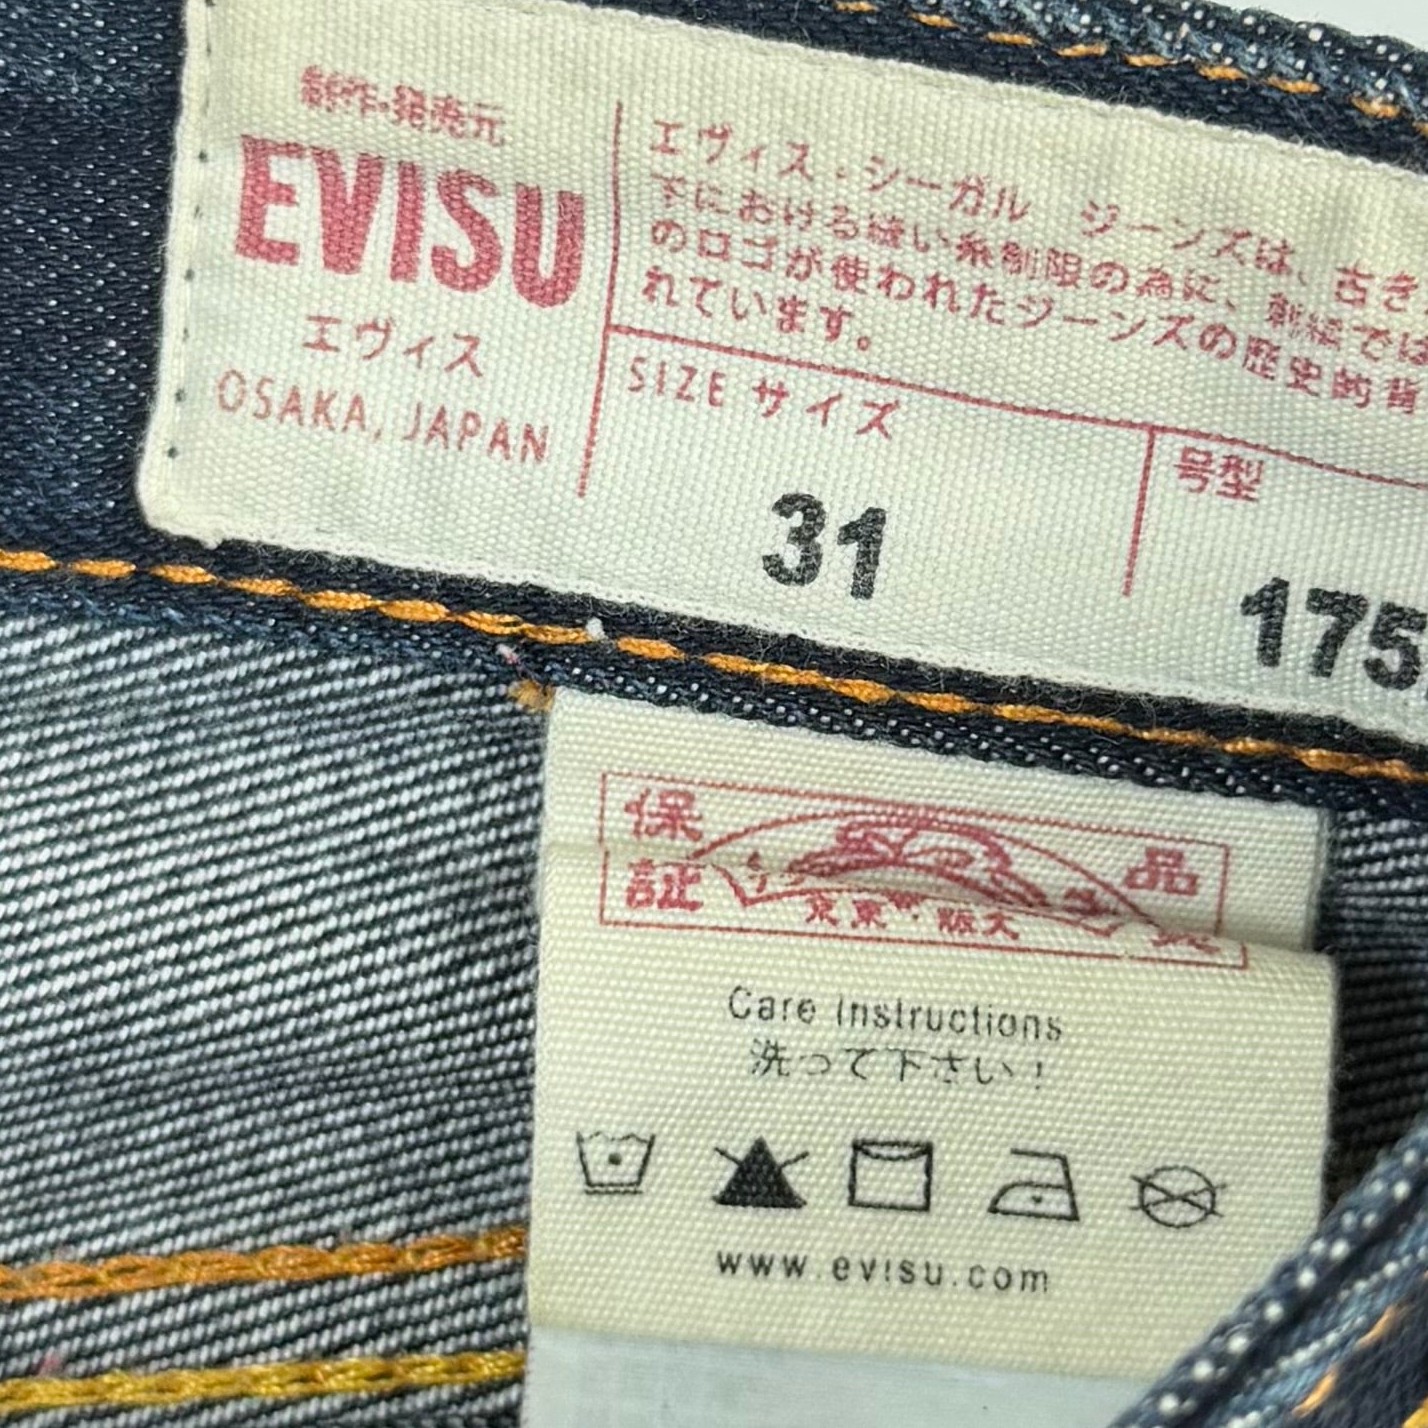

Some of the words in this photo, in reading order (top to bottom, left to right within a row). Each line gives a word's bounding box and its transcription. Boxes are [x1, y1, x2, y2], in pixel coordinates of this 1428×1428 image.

[234, 134, 586, 309] EVISU
[302, 316, 483, 378] エヴィス
[642, 265, 872, 351] れています。
[217, 370, 381, 440] OSAKA,
[404, 403, 550, 463] JAPAN
[628, 356, 725, 407] SIZE
[753, 377, 901, 440] サイズ
[1174, 445, 1265, 503] 号型
[762, 493, 888, 600] 31
[728, 984, 817, 1024] Care
[836, 993, 1063, 1042] Instructions
[716, 1250, 1049, 1293] www.evisu.com
